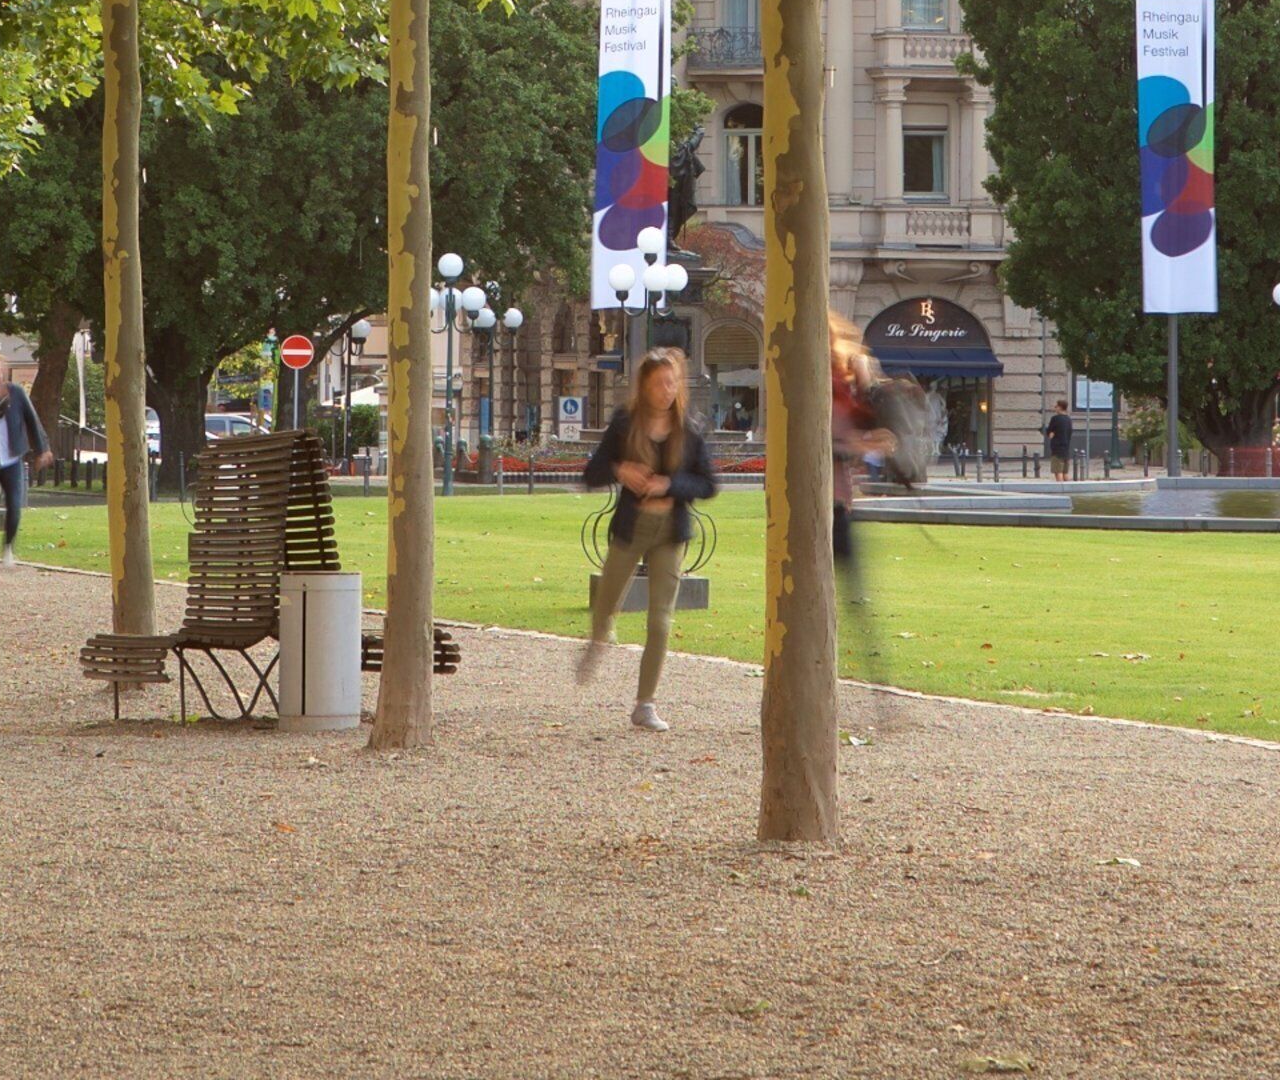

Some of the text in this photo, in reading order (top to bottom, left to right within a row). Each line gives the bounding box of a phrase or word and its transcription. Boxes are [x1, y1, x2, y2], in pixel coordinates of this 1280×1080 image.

[605, 6, 657, 20] Rheingau
[1142, 10, 1200, 26] Rheingau
[604, 23, 637, 36] Musik
[1142, 28, 1179, 40] Musik
[604, 40, 646, 53] Festival
[1143, 45, 1189, 57] Festival
[885, 323, 968, 343] La Lingerie
